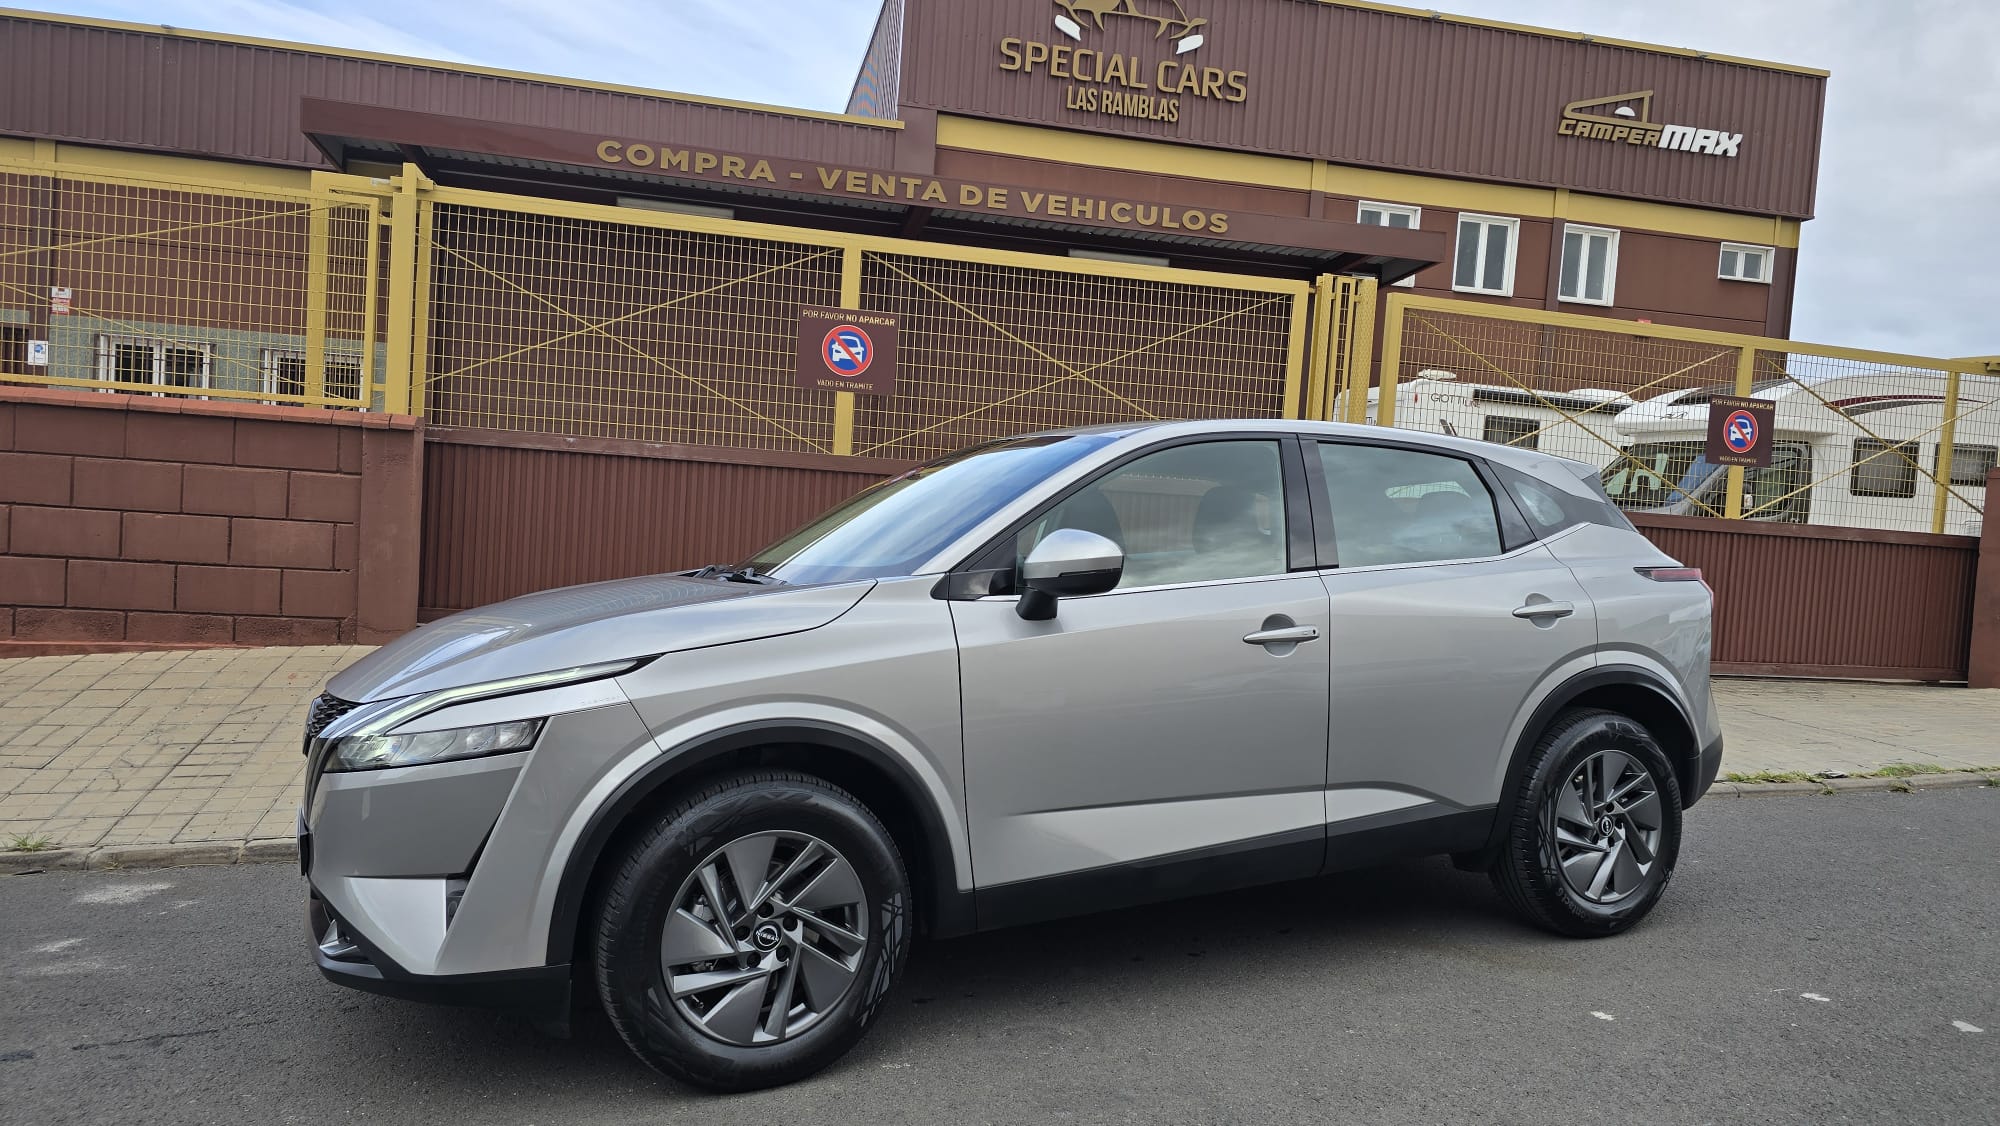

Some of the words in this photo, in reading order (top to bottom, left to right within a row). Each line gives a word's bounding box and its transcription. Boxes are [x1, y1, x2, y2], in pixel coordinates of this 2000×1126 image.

[999, 37, 1149, 89] SPECIAL
[1156, 60, 1248, 103] CARS
[1066, 85, 1098, 112] LAS
[1101, 90, 1180, 123] RAMBLAS
[596, 140, 777, 183] COMPRA
[816, 166, 948, 204] VENTA
[959, 184, 1009, 210] DE
[1020, 191, 1230, 234] VEHICULOS
[802, 309, 819, 319] POR
[820, 311, 845, 321] FAVOR
[846, 313, 858, 323] NO
[858, 315, 896, 327] APARCAR
[817, 379, 834, 387] VADO
[835, 380, 845, 388] EN
[845, 381, 874, 391] TRAMITE
